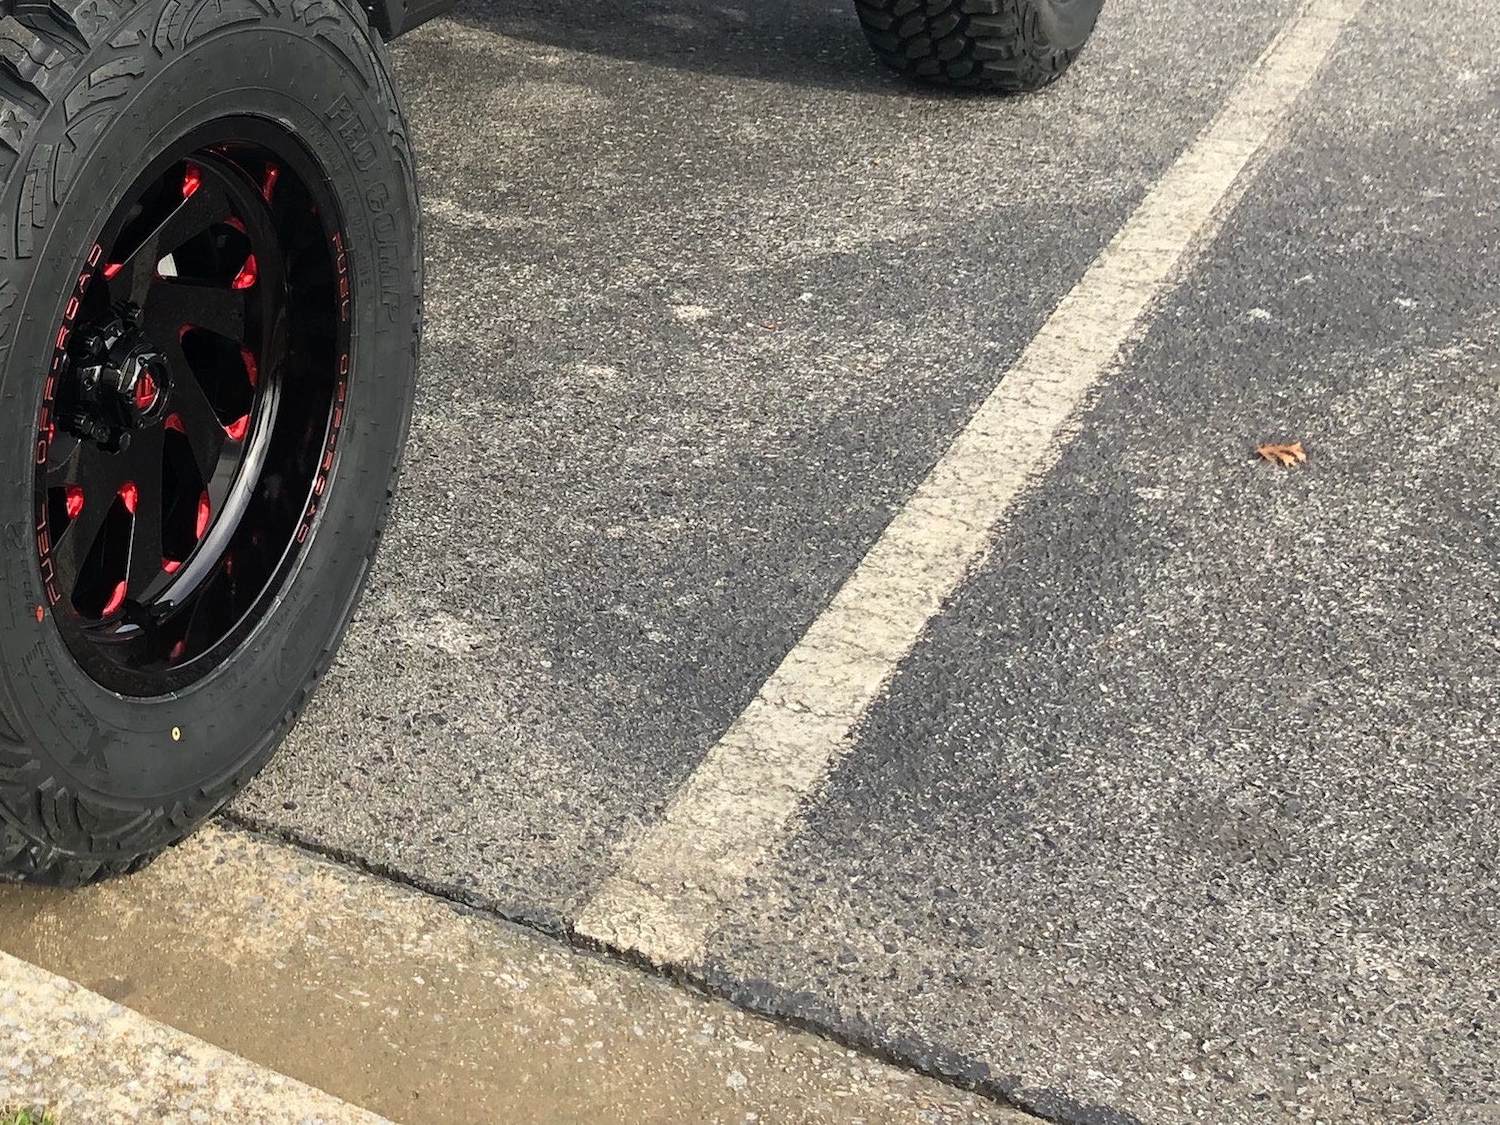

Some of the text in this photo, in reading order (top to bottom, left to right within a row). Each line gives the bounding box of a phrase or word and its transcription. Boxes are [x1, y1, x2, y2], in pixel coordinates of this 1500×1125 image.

[325, 92, 400, 324] PRO COMP
[35, 243, 103, 606] FUEL OFF-ROAD
